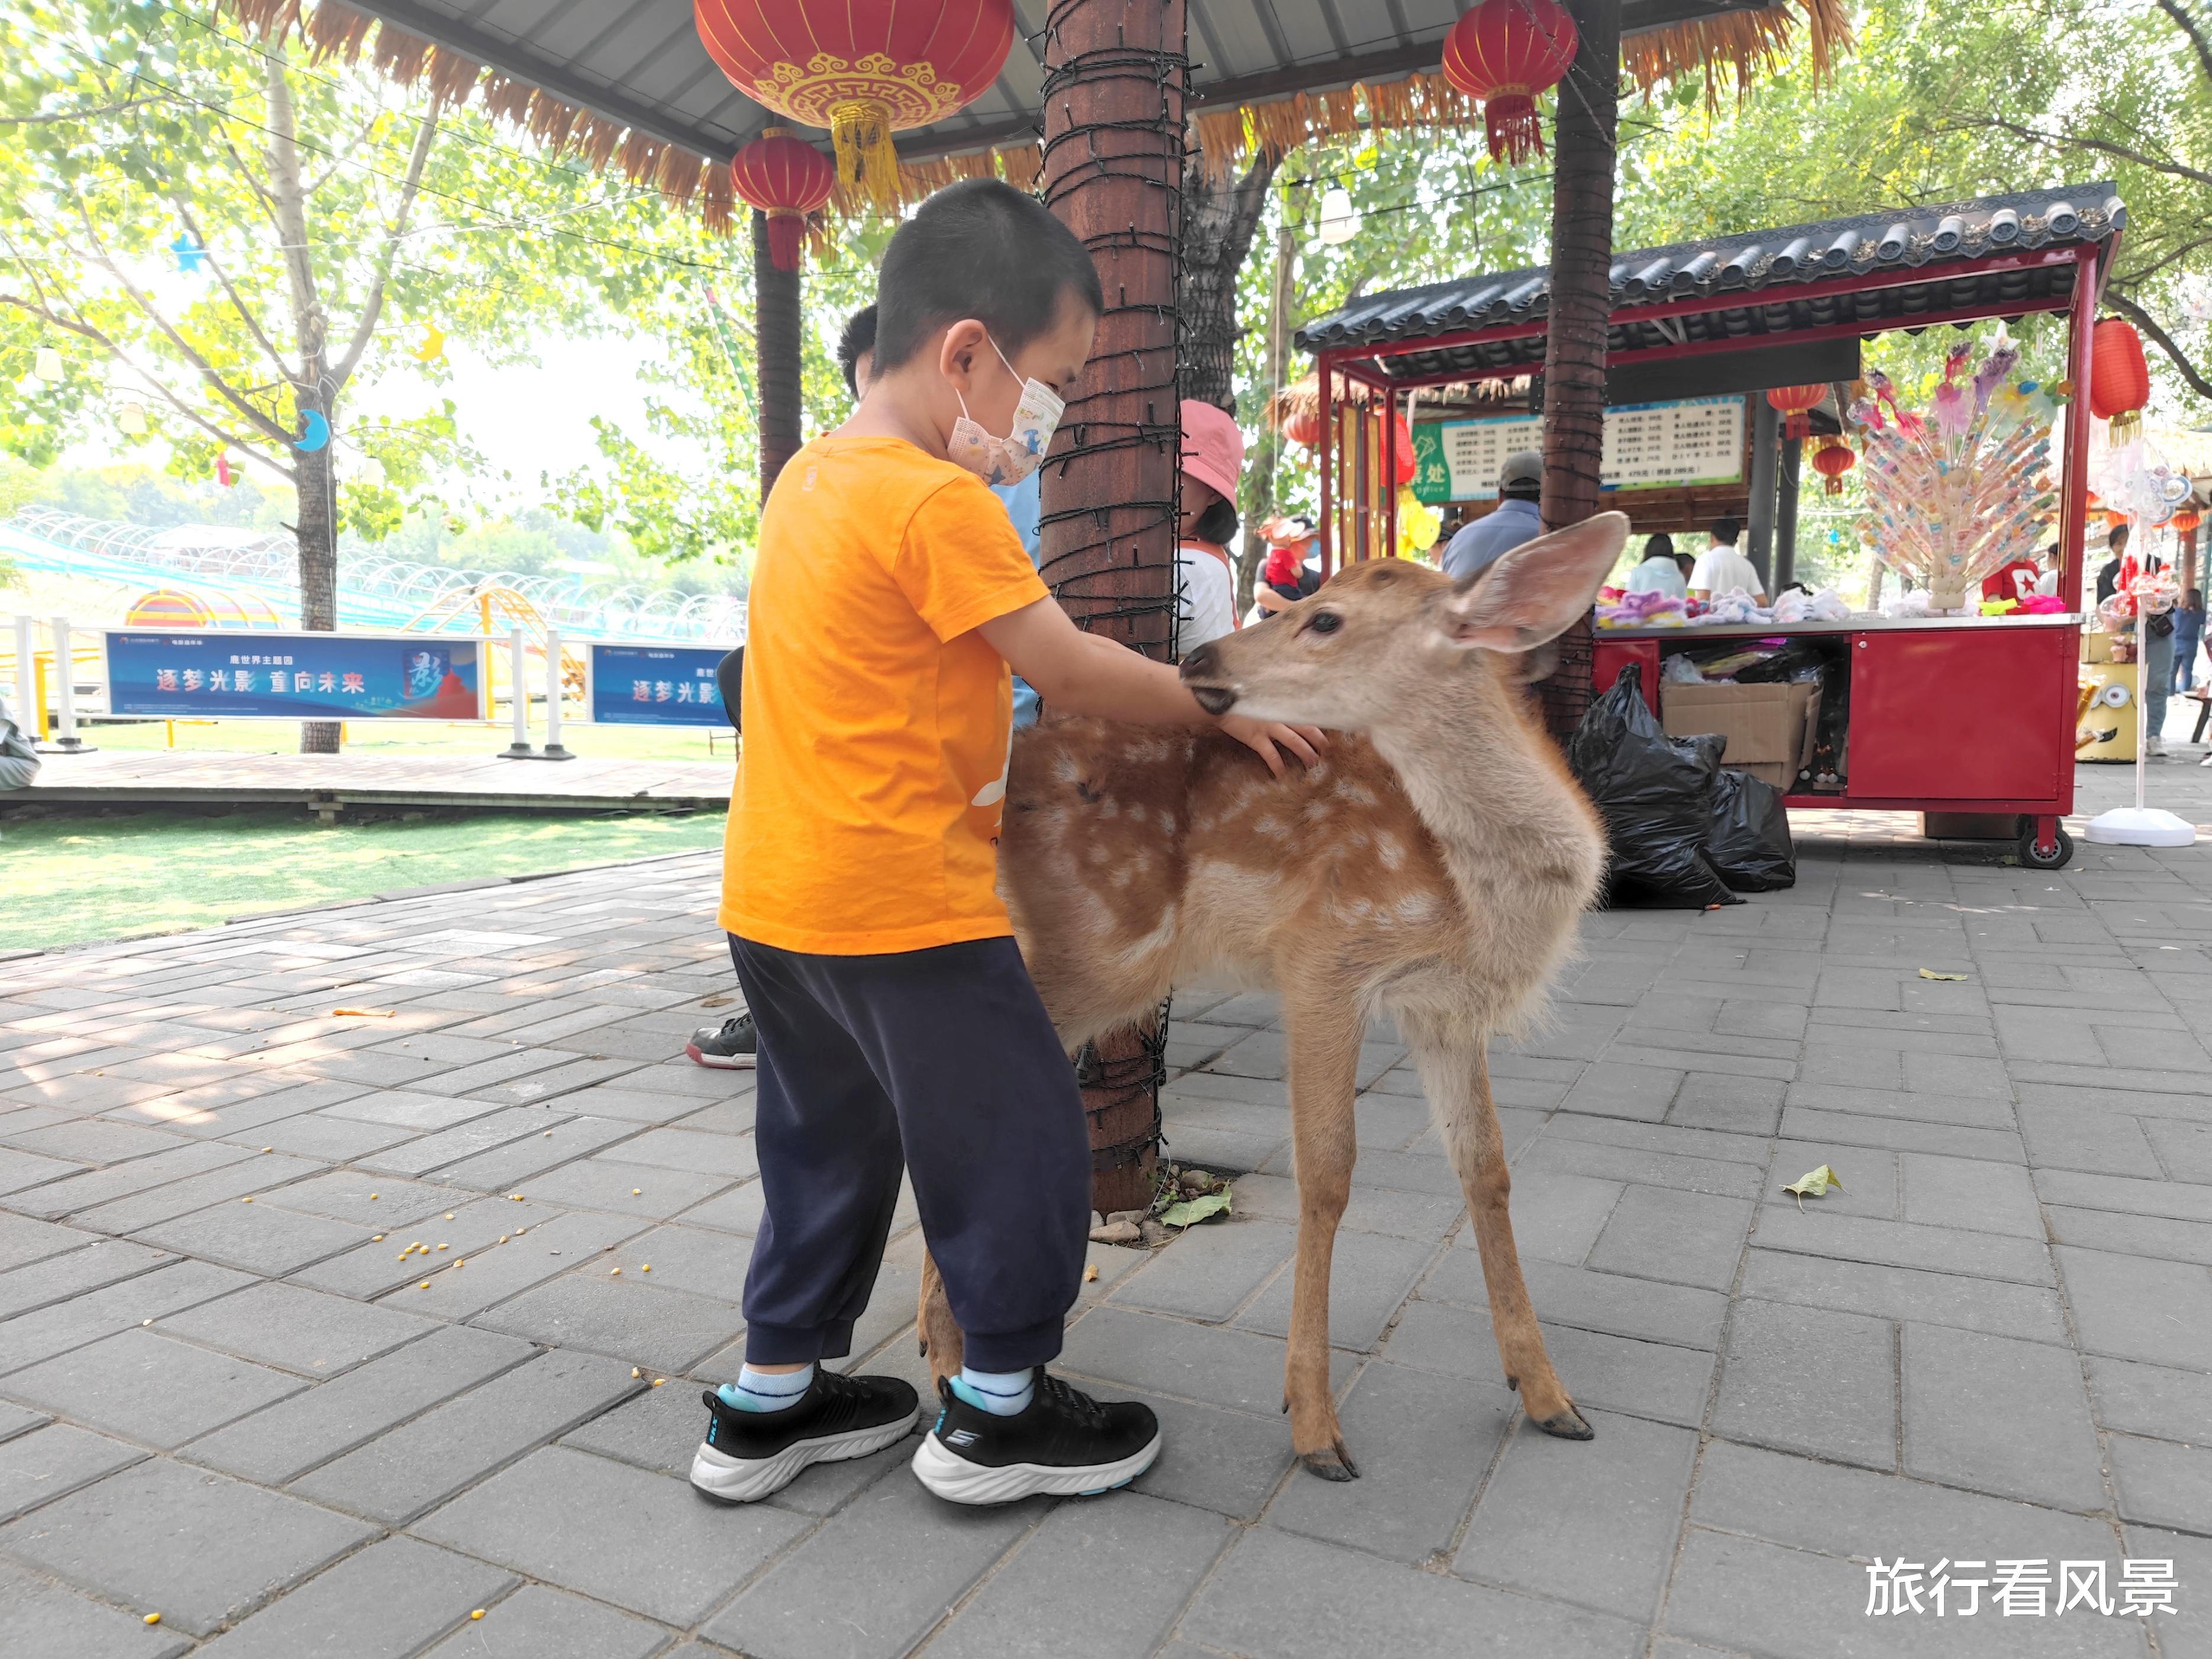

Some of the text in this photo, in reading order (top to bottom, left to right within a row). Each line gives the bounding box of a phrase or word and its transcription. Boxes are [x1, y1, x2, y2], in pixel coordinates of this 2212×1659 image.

[230, 655, 293, 666] 鹿世界主题园
[696, 667, 716, 677] 鹿世
[156, 669, 365, 695] 逐梦光影 童向未来
[632, 679, 719, 704] 逐梦光影
